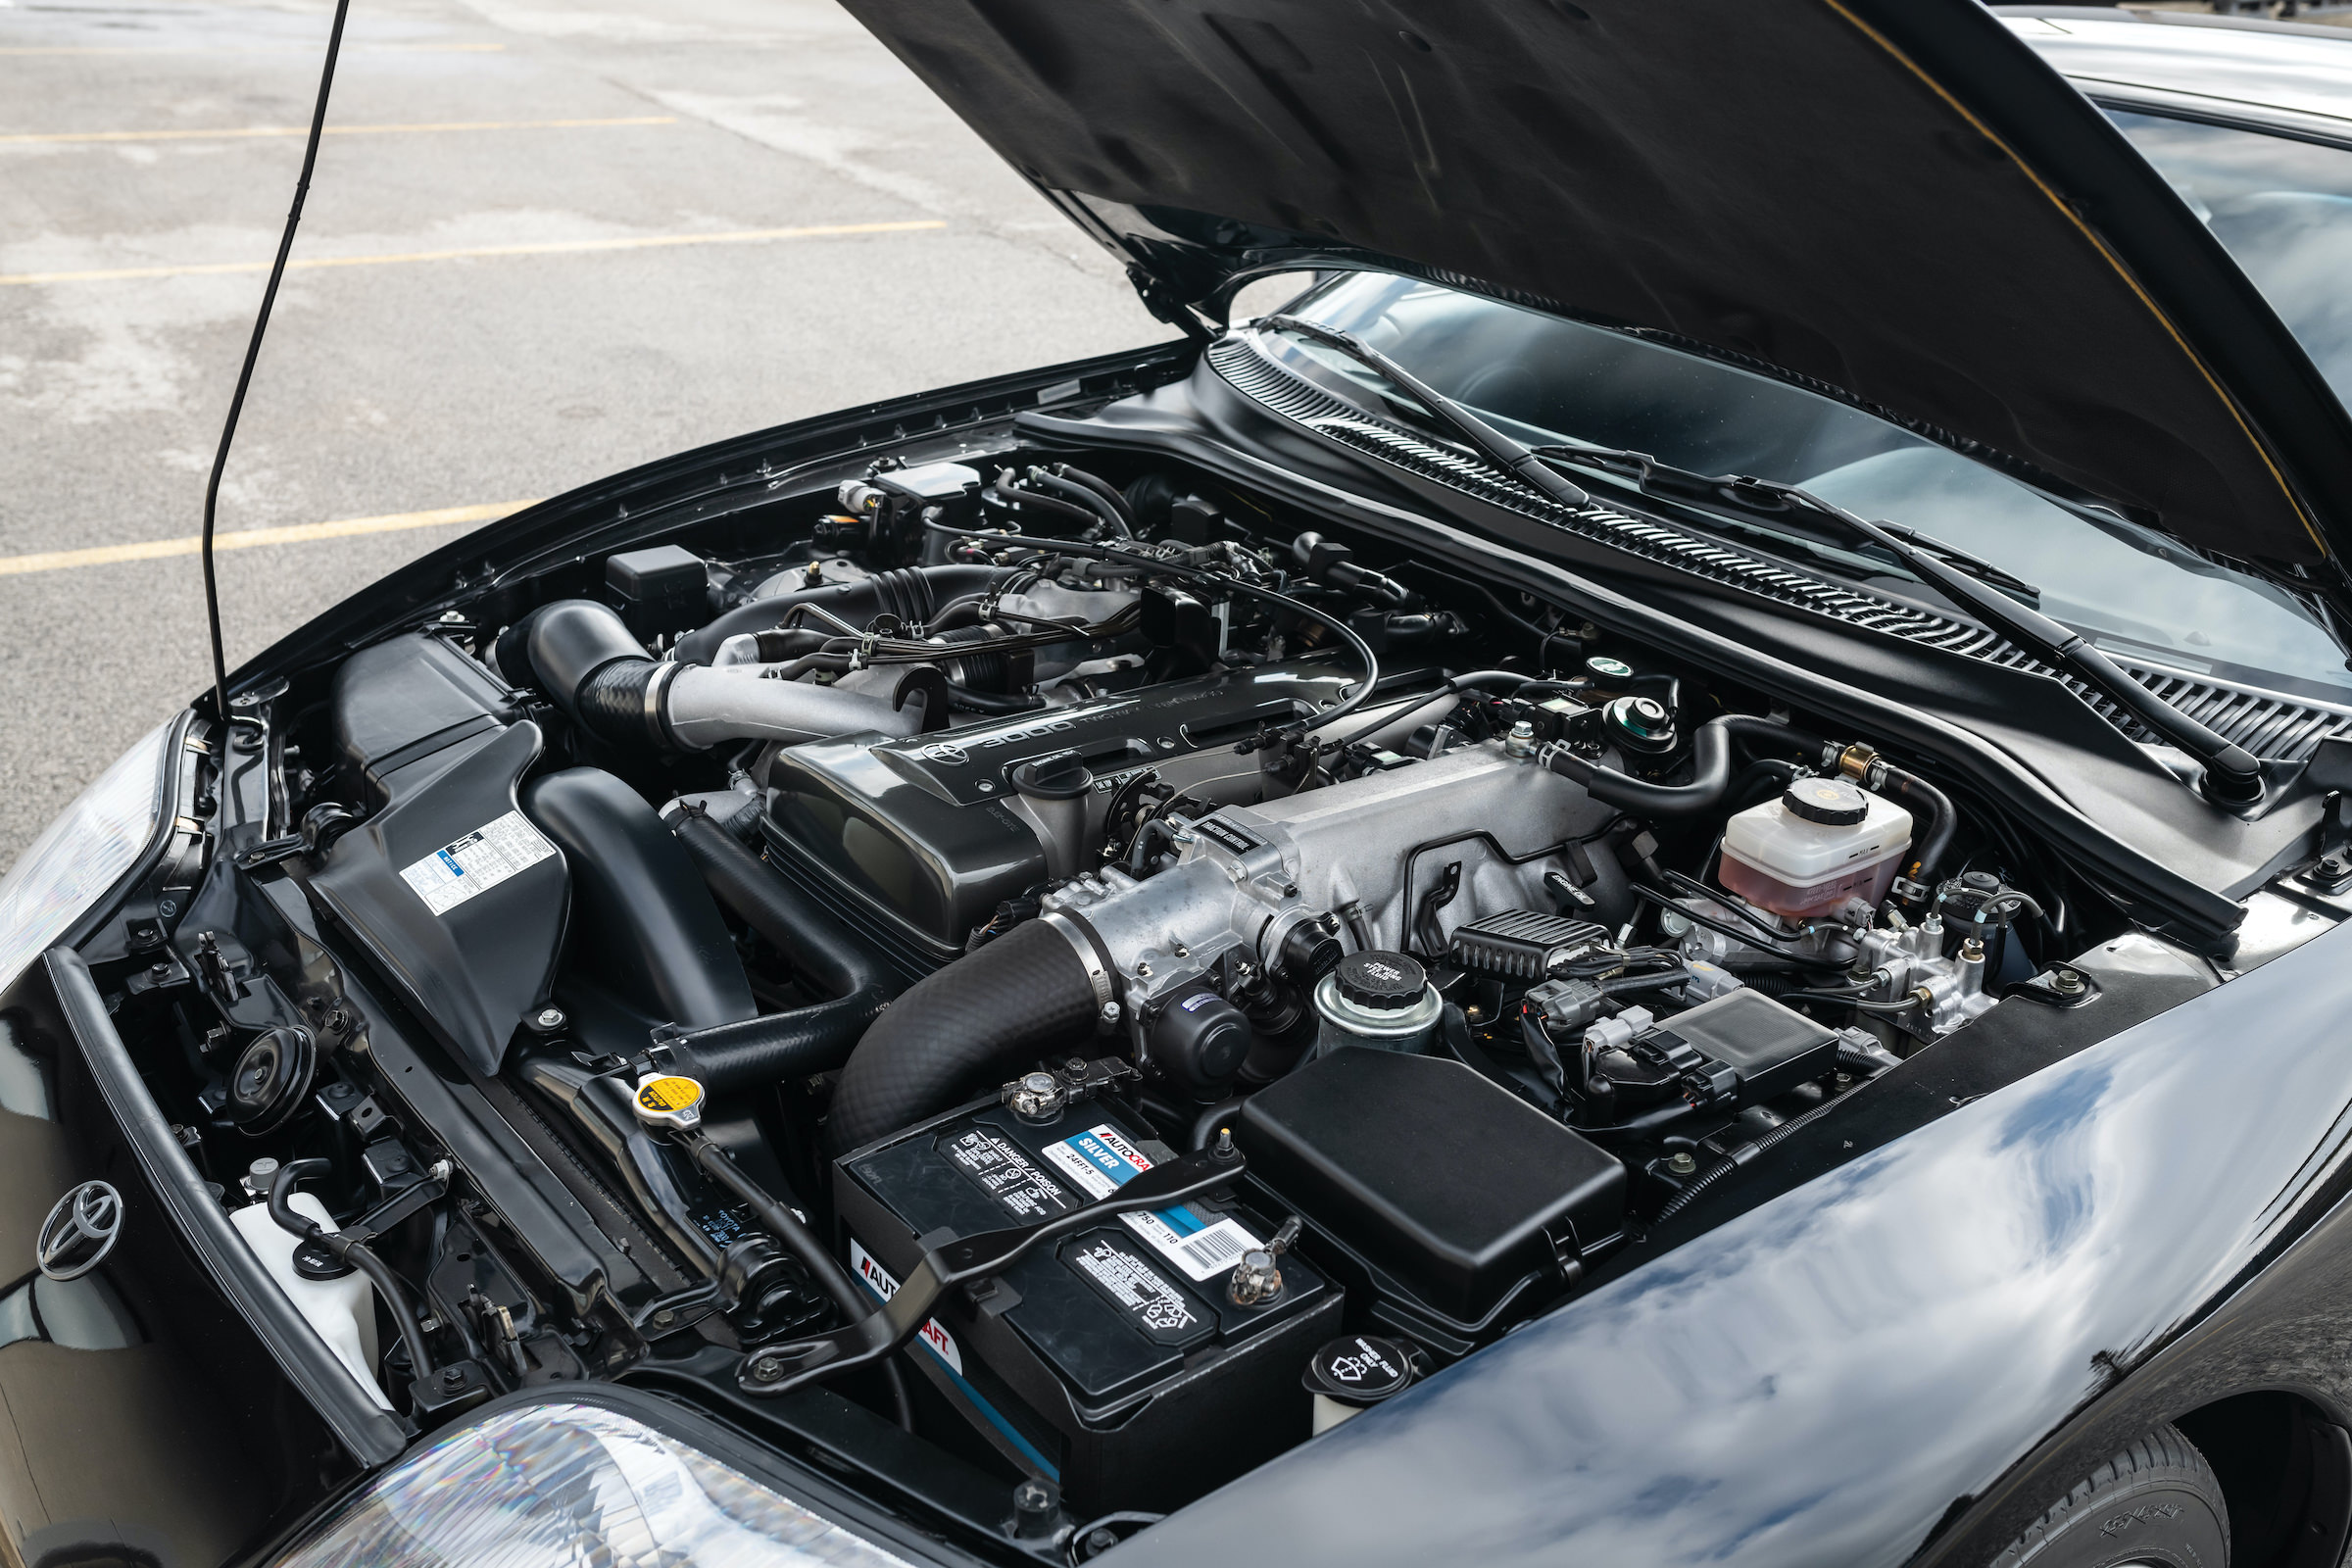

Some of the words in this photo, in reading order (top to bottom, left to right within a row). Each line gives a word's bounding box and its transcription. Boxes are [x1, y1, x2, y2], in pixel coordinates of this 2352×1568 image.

[982, 721, 1077, 748] 3000
[1200, 821, 1229, 838] TRACTION
[1223, 833, 1250, 850] CONTROL
[443, 856, 459, 871] NOTICE
[1551, 874, 1578, 892] ENGINE
[1367, 969, 1389, 980] FLUID
[1374, 961, 1400, 975] POWER
[1066, 1153, 1094, 1175] 24FFT-5
[1078, 1137, 1119, 1169] SILVER
[1104, 1137, 1150, 1172] AUTOCRA
[997, 1142, 1029, 1168] DANGER
[1031, 1170, 1061, 1196] POISON
[718, 1209, 740, 1231] TOYOTA
[1137, 1211, 1154, 1225] 750
[1162, 1233, 1179, 1245] 110
[1355, 1338, 1381, 1361] WASHER
[1379, 1360, 1398, 1378] FLUID
[1360, 1352, 1379, 1368] ONLY
